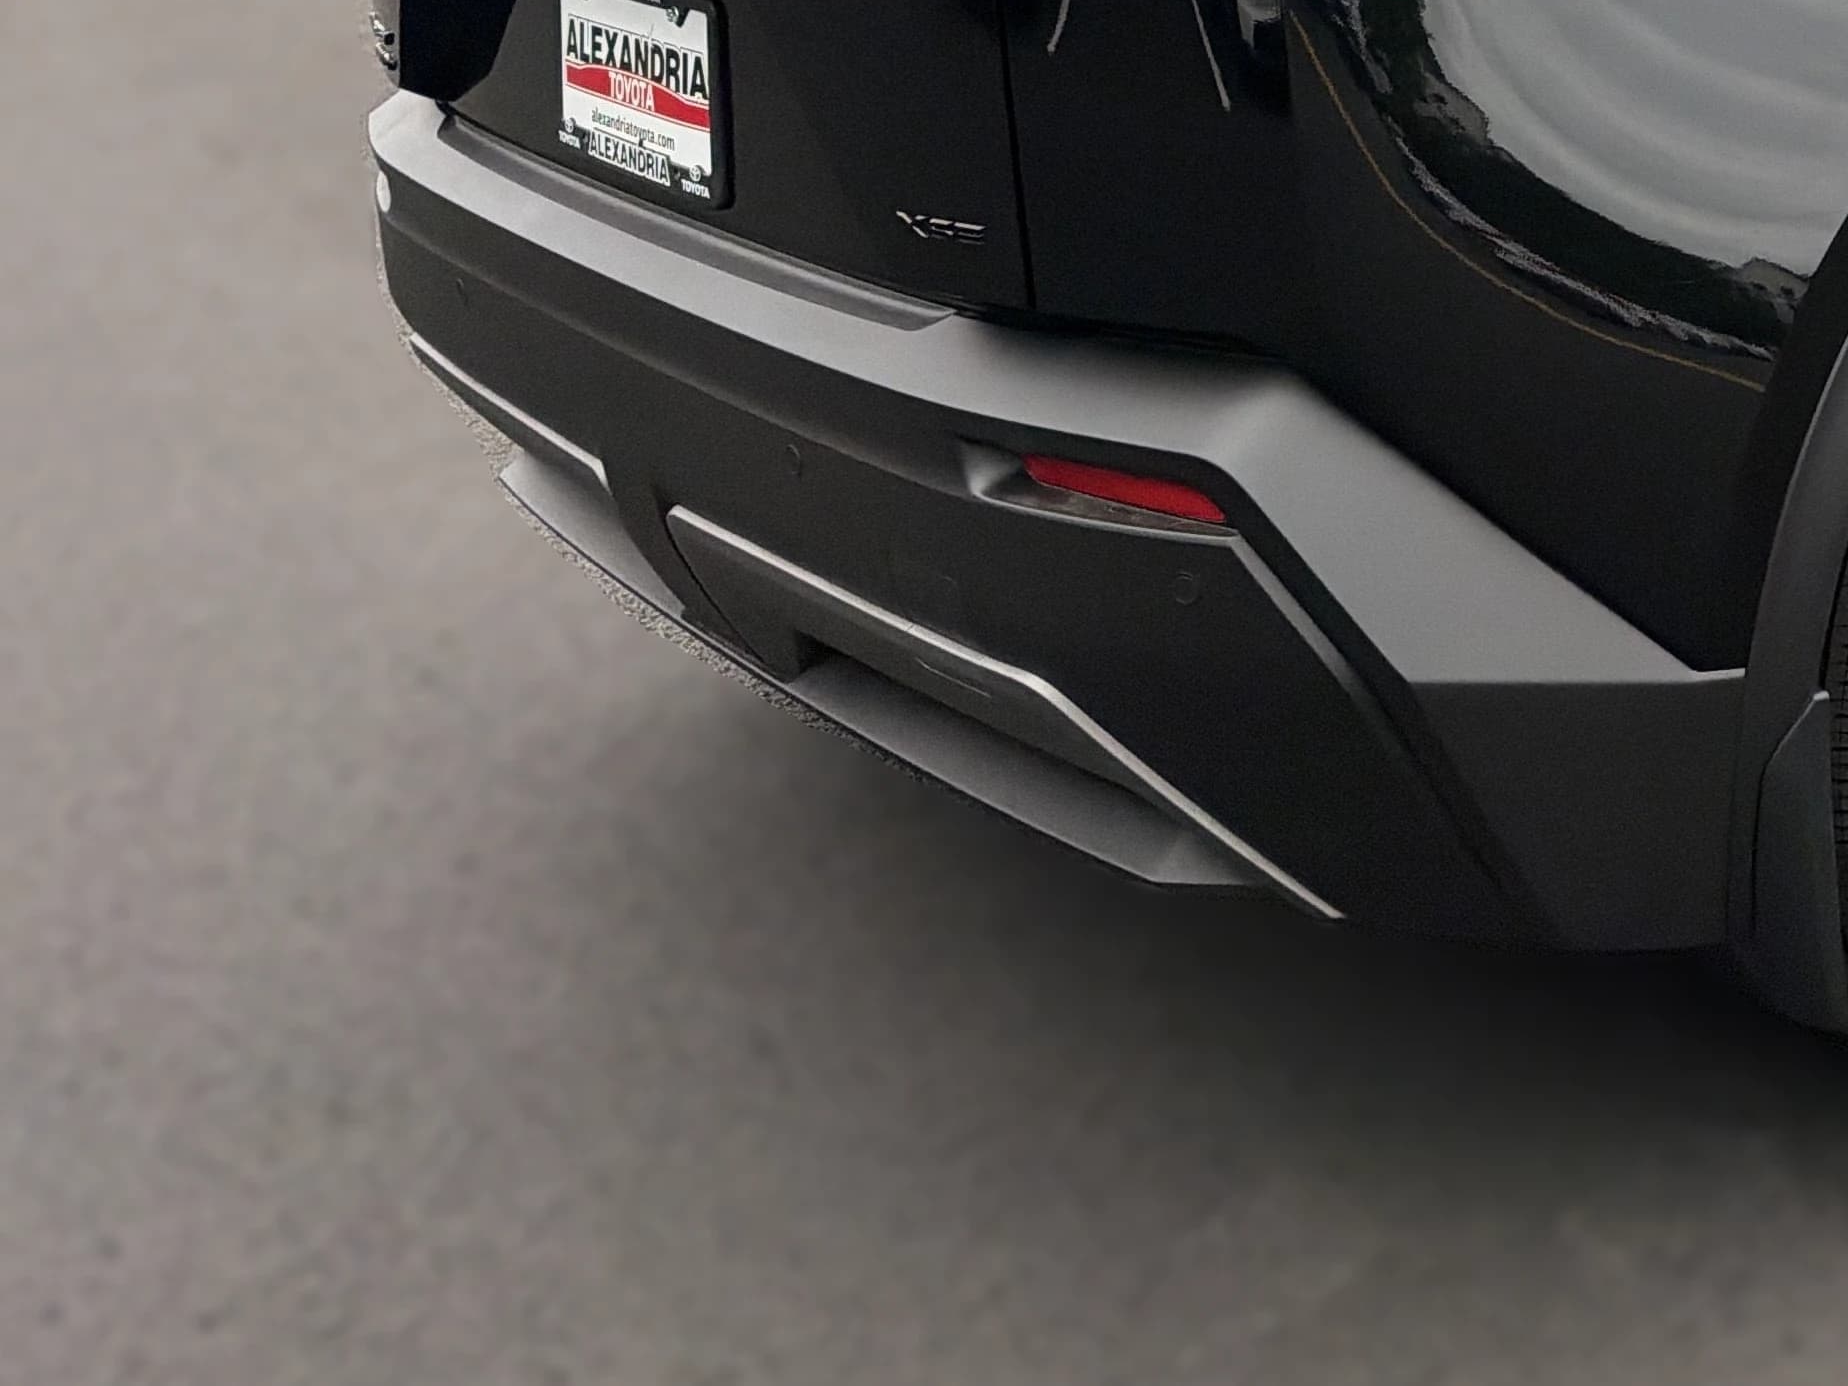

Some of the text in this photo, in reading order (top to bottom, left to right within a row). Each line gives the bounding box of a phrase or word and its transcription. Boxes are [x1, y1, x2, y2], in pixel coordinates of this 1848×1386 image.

[566, 17, 709, 100] ALEXANDRIA
[608, 71, 655, 112] TOYOTA
[558, 129, 581, 149] TOYOTA
[591, 107, 675, 151] alexandriatoyota.com
[588, 129, 671, 187] ALEXANDRIA
[681, 178, 710, 199] TOYOTA
